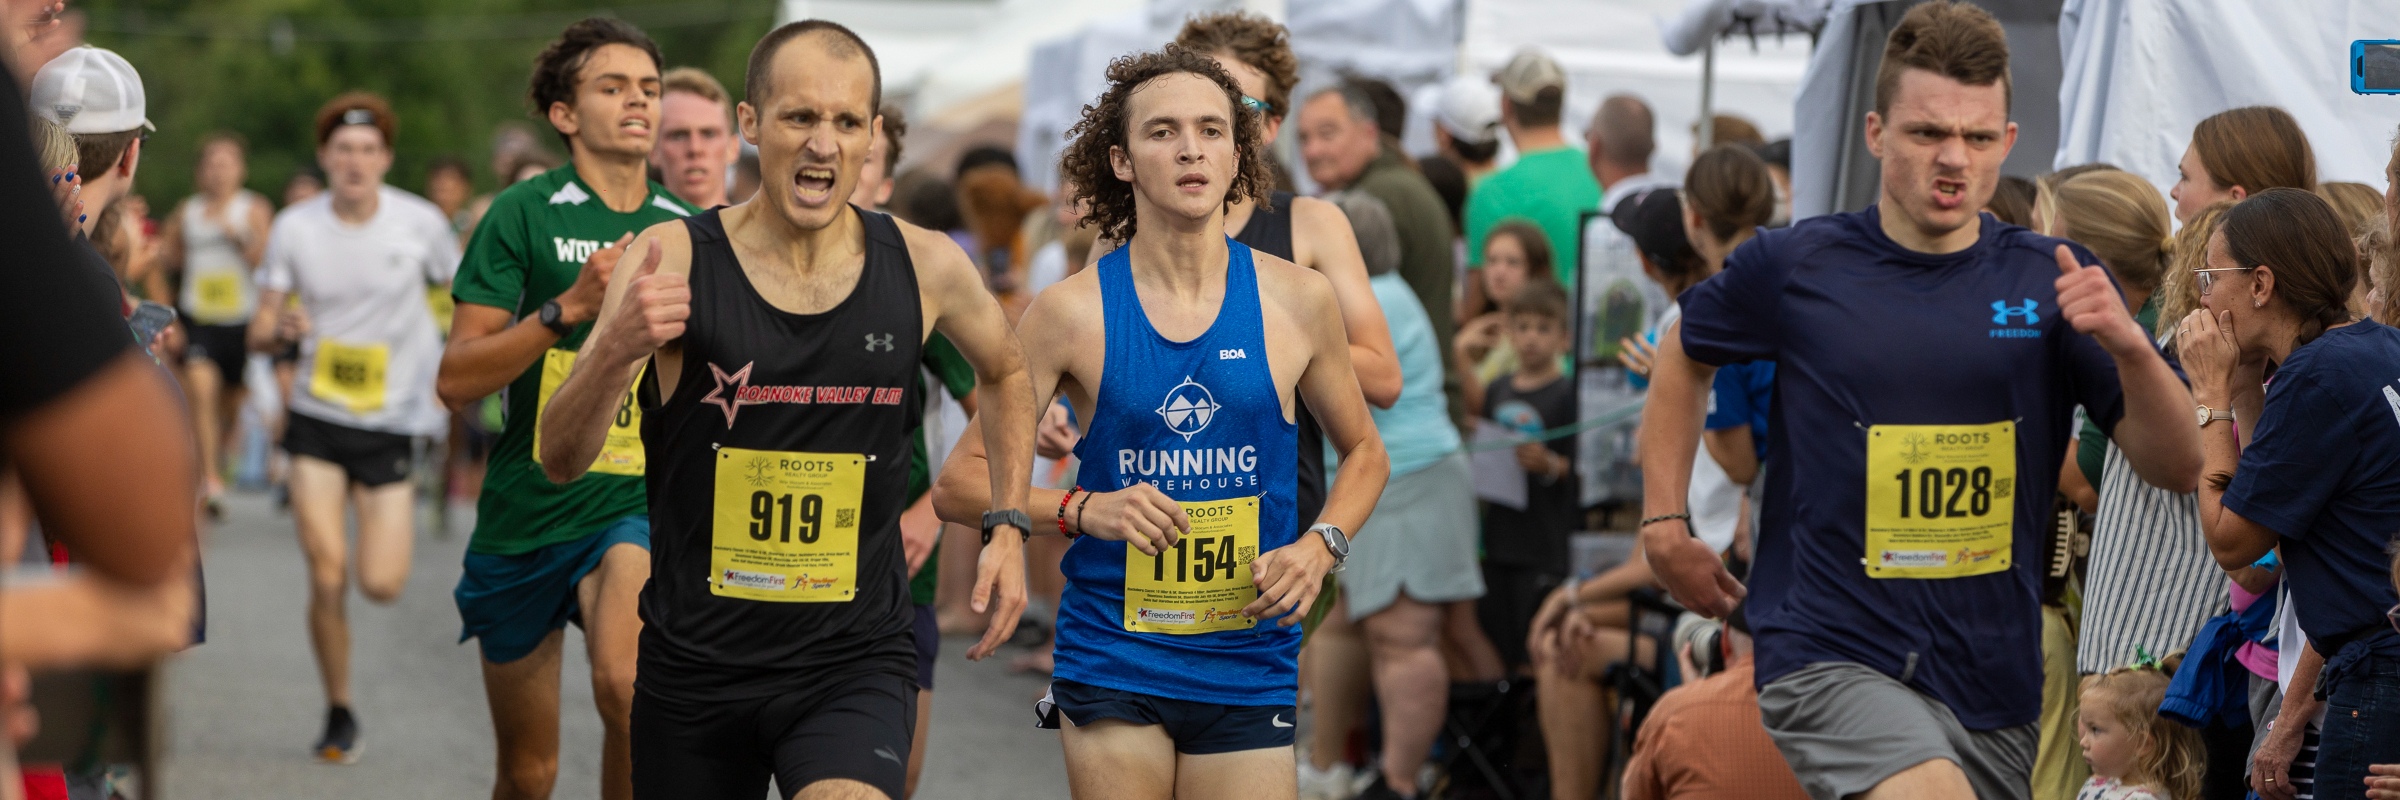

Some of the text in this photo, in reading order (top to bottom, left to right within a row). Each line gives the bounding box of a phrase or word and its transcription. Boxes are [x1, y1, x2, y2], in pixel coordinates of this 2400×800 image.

[1989, 329, 2041, 339] FREEDOM
[736, 385, 904, 405] ROANOKE VALLEY ELITE
[1935, 432, 1991, 445] ROOTS
[780, 459, 834, 472] ROOTS
[1118, 444, 1258, 477] RUNNING
[1895, 466, 1993, 519] 1028
[749, 489, 823, 545] 919
[1186, 505, 1234, 518] ROOTS
[1150, 534, 1238, 583] 1154
[734, 571, 785, 586] FreedomFirst
[1147, 610, 1196, 620] FreedomFirst
